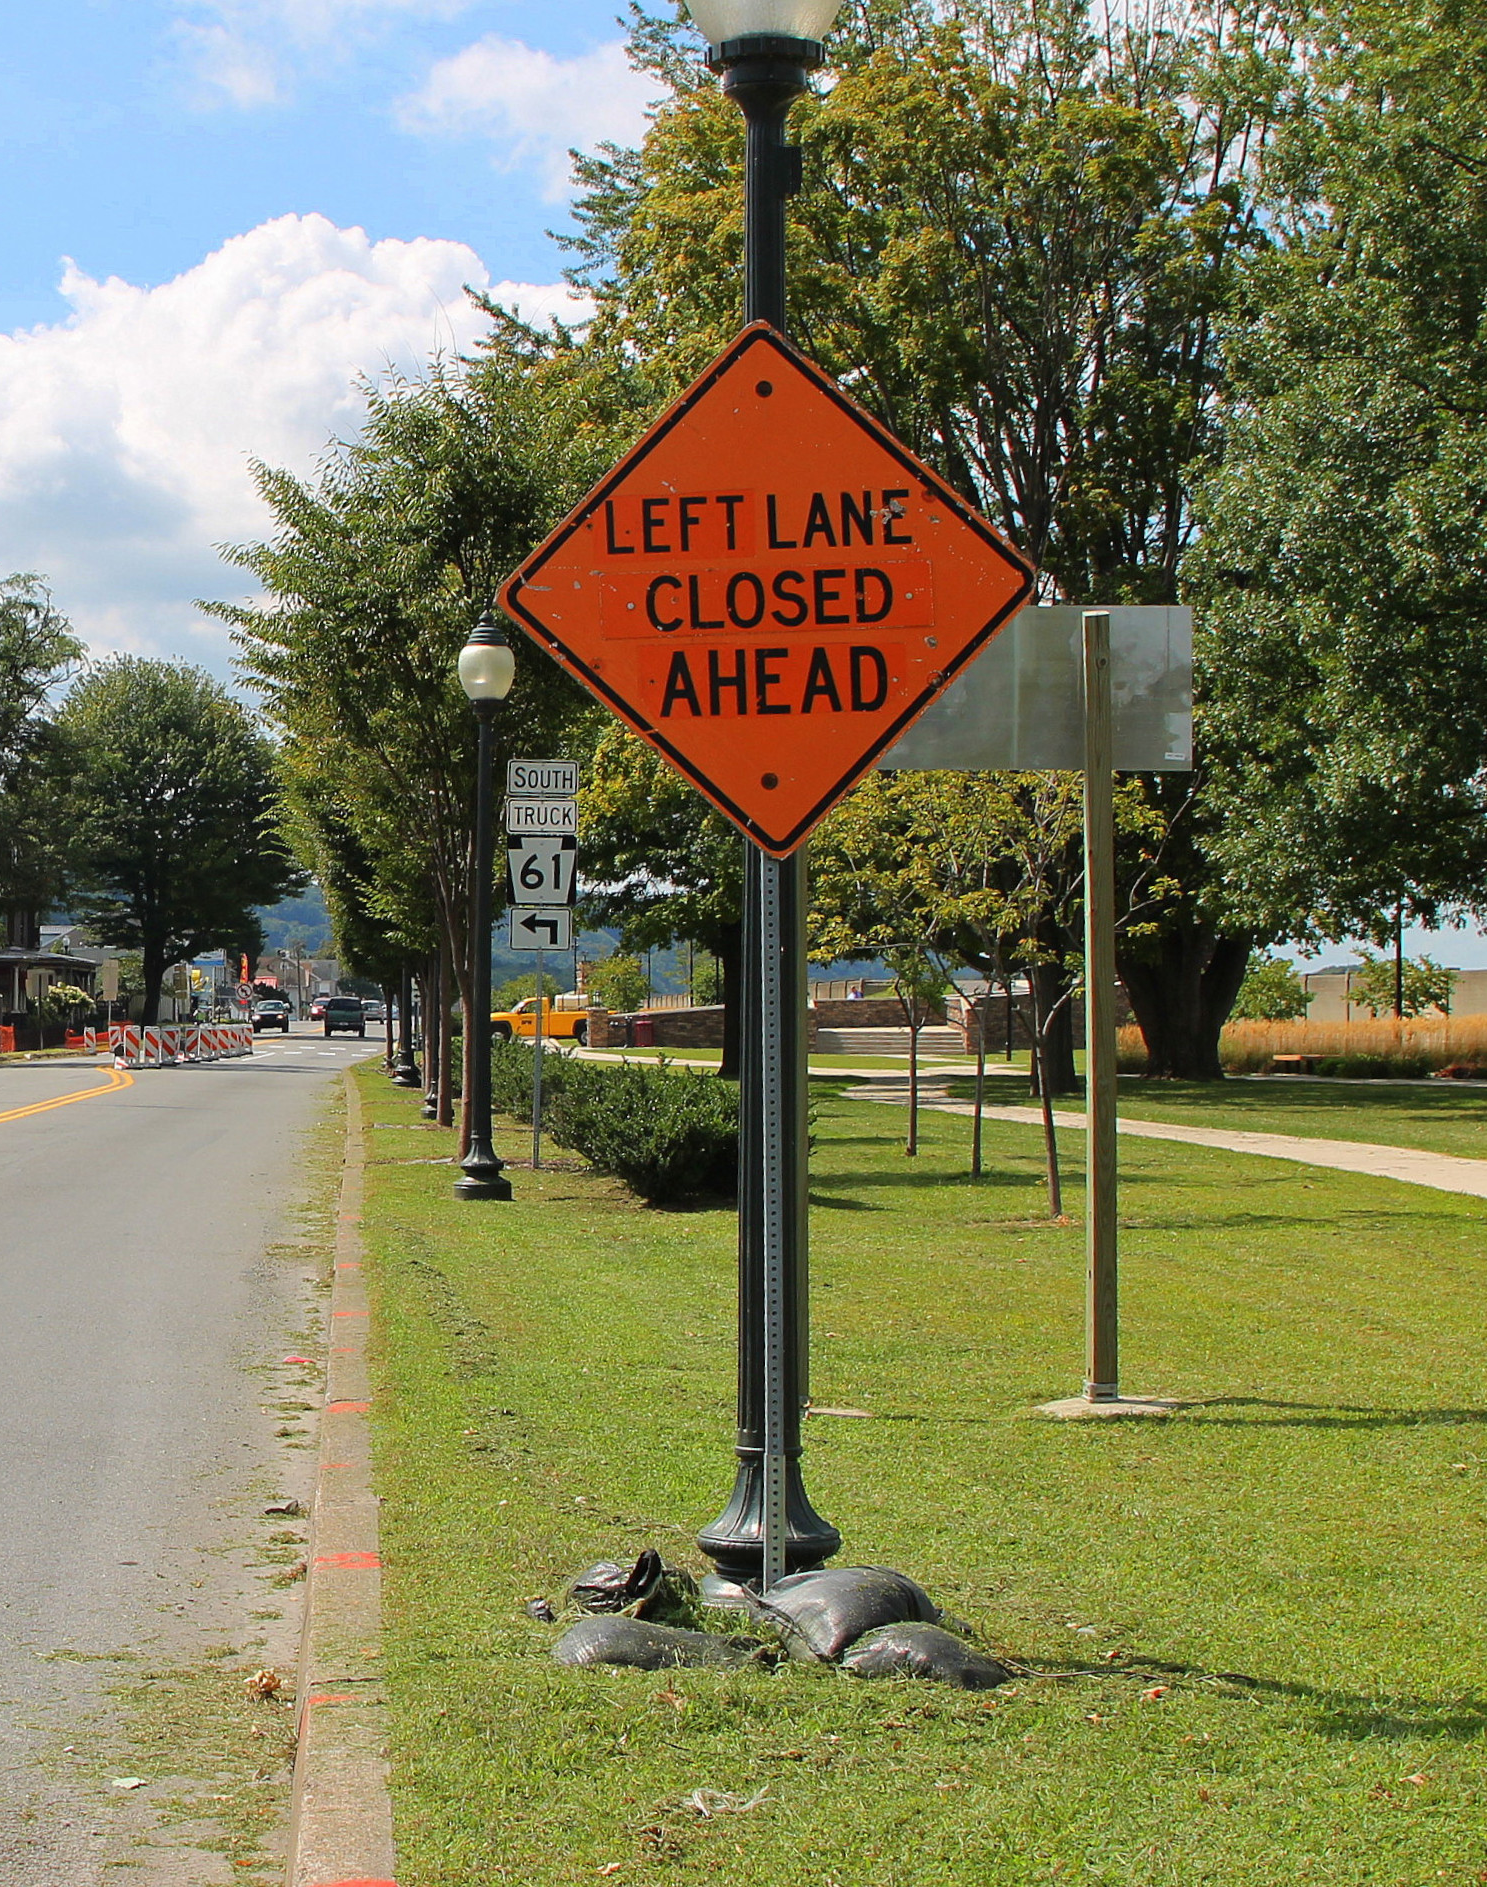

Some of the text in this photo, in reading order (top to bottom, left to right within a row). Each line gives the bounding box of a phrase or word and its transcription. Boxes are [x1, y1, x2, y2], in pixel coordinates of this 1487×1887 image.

[605, 489, 913, 555] LEFT LANE
[645, 567, 894, 632] CLOSED
[660, 646, 889, 718] AHEAD
[514, 766, 574, 789] SOUTH
[514, 806, 573, 826] TRUCK
[520, 853, 561, 890] 61
